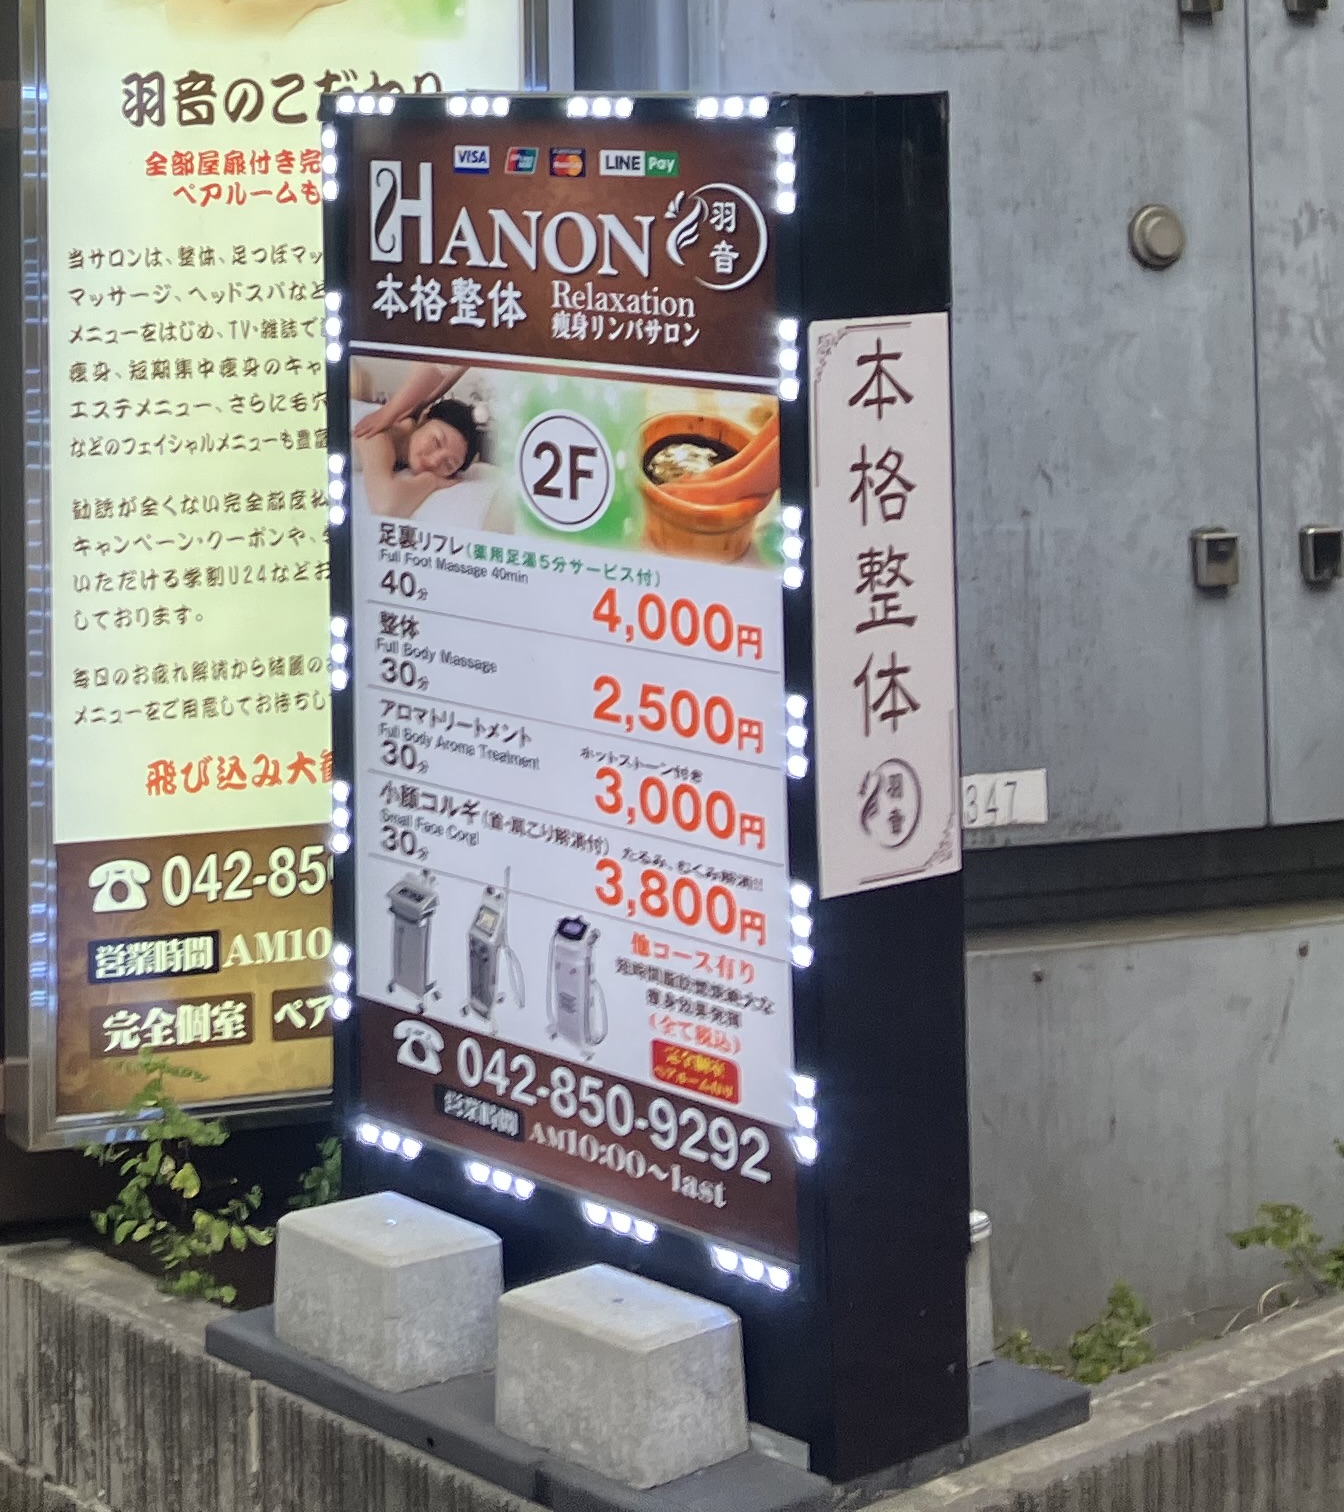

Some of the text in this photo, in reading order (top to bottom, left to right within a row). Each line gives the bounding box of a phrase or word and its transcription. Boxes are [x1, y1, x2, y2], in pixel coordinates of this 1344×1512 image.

[458, 150, 487, 163] VISA
[605, 155, 675, 173] LINE Pay
[369, 160, 656, 278] HANON
[709, 200, 740, 274] 羽音
[372, 273, 527, 328] 本格整体
[551, 280, 696, 318] Relaxation
[532, 441, 598, 501] 2F
[848, 337, 921, 737] 本格整体
[378, 548, 529, 585] Full Foot Massage 40min
[379, 610, 420, 639] 整体
[592, 587, 764, 661] 4,000円
[376, 638, 497, 674] Full Body Massage
[379, 698, 532, 748] アロマトリートメント
[592, 674, 764, 755] 2,500円
[378, 722, 400, 738] Full
[404, 727, 433, 749] Body
[479, 743, 540, 771] Treatment
[594, 766, 765, 850] 3,000円
[162, 845, 334, 907] 042-85
[594, 857, 766, 947] 3,800円
[95, 936, 214, 979] 営業時間
[102, 1000, 248, 1053] 完全個室
[456, 1037, 772, 1184] 042-850-9292
